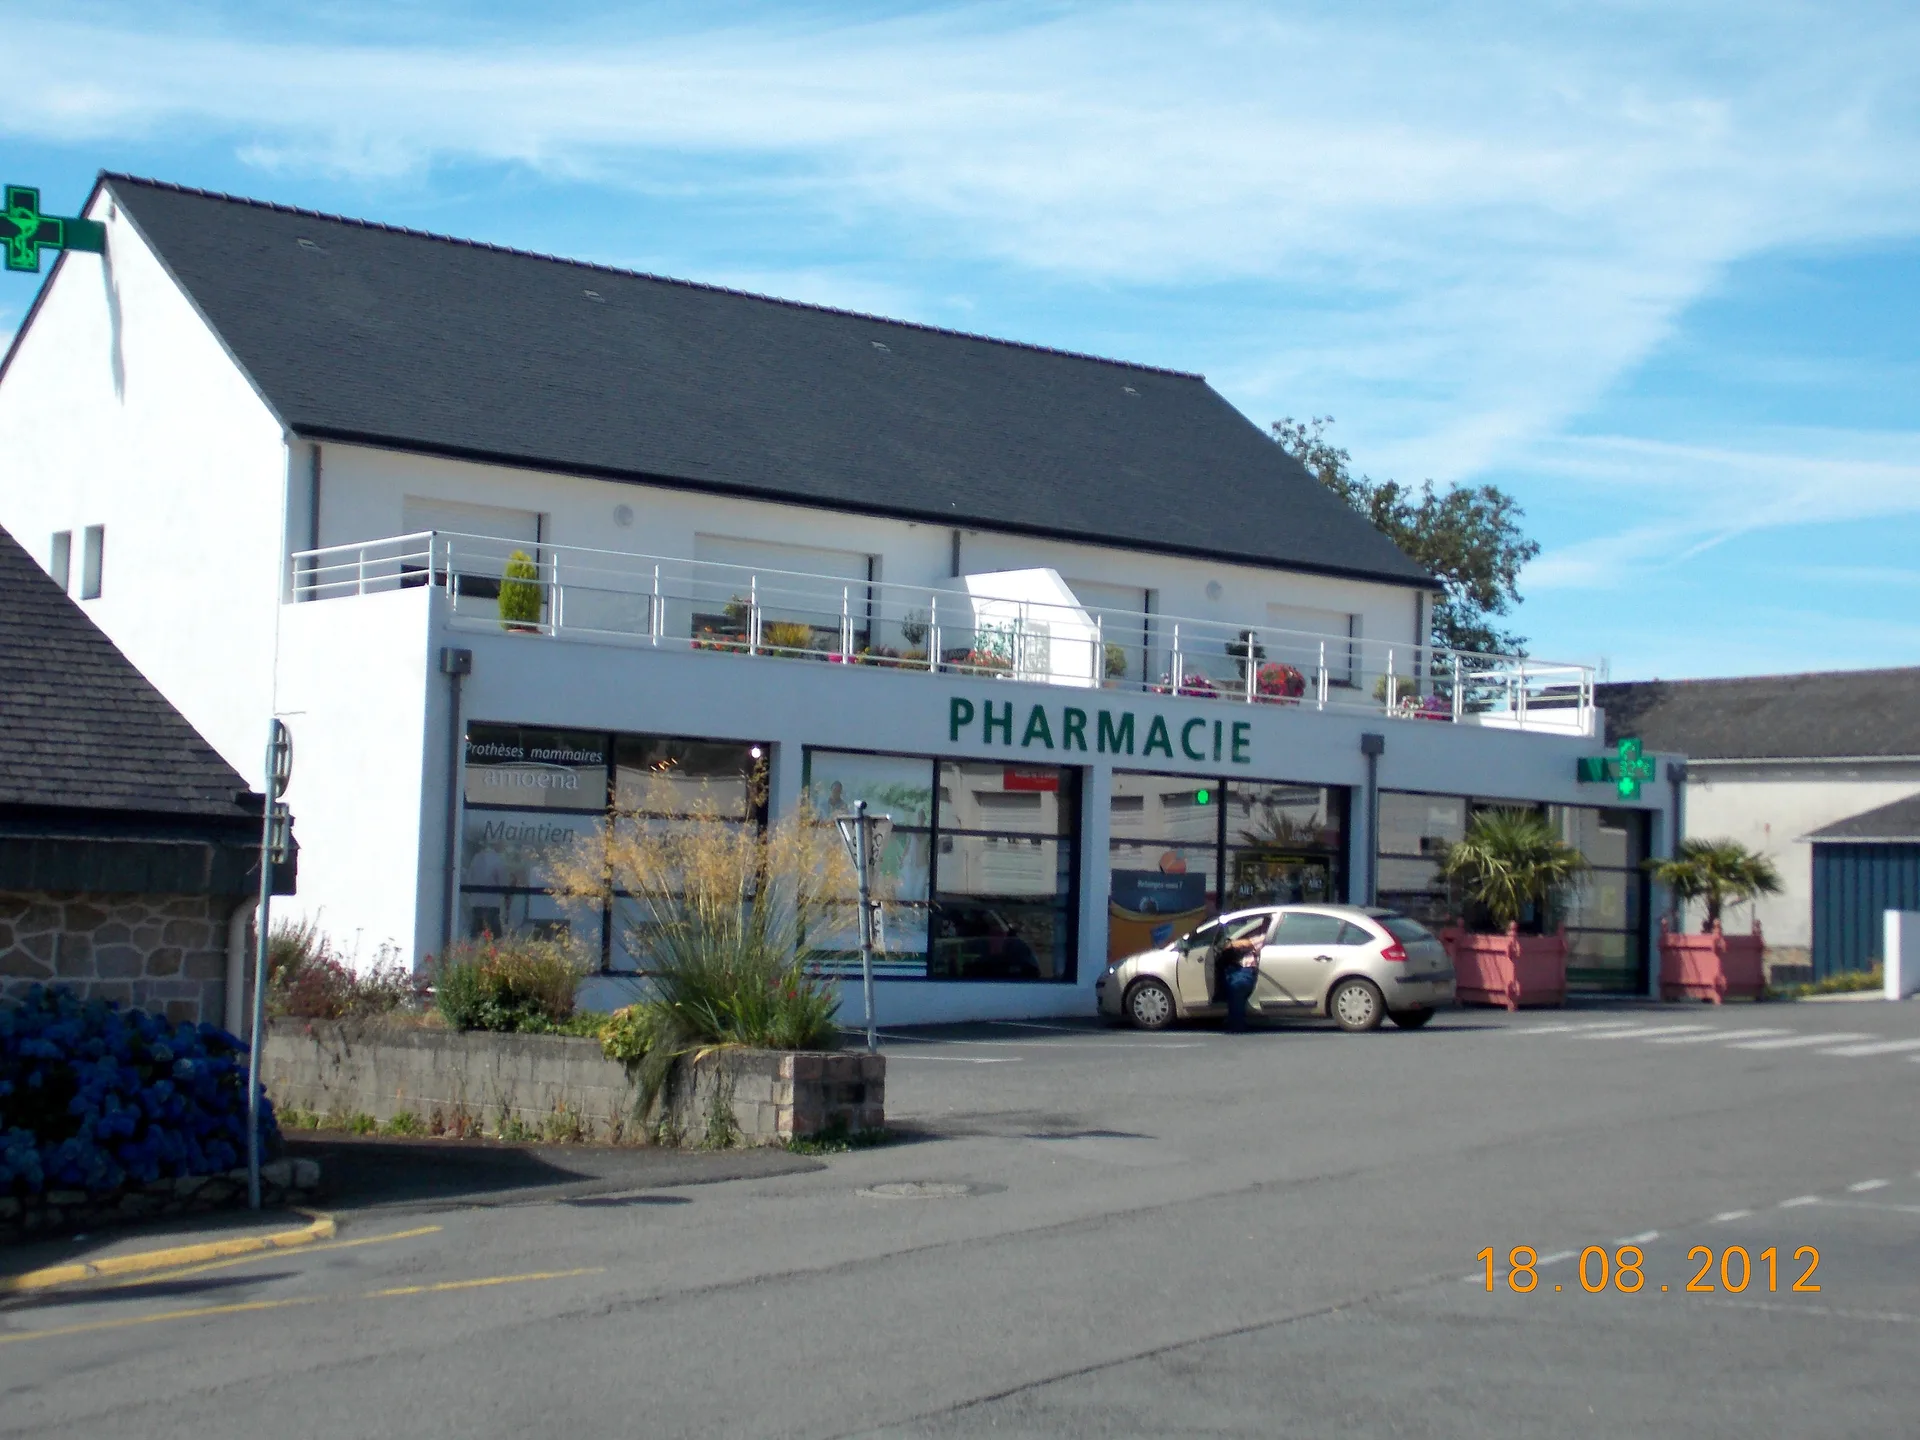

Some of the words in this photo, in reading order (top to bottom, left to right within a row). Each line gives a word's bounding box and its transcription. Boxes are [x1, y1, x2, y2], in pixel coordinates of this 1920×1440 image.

[949, 696, 1251, 764] PHARMACIE
[465, 741, 524, 758] Prothèses
[530, 747, 602, 763] mammaires
[484, 769, 579, 790] amoena
[483, 819, 575, 843] Maintien
